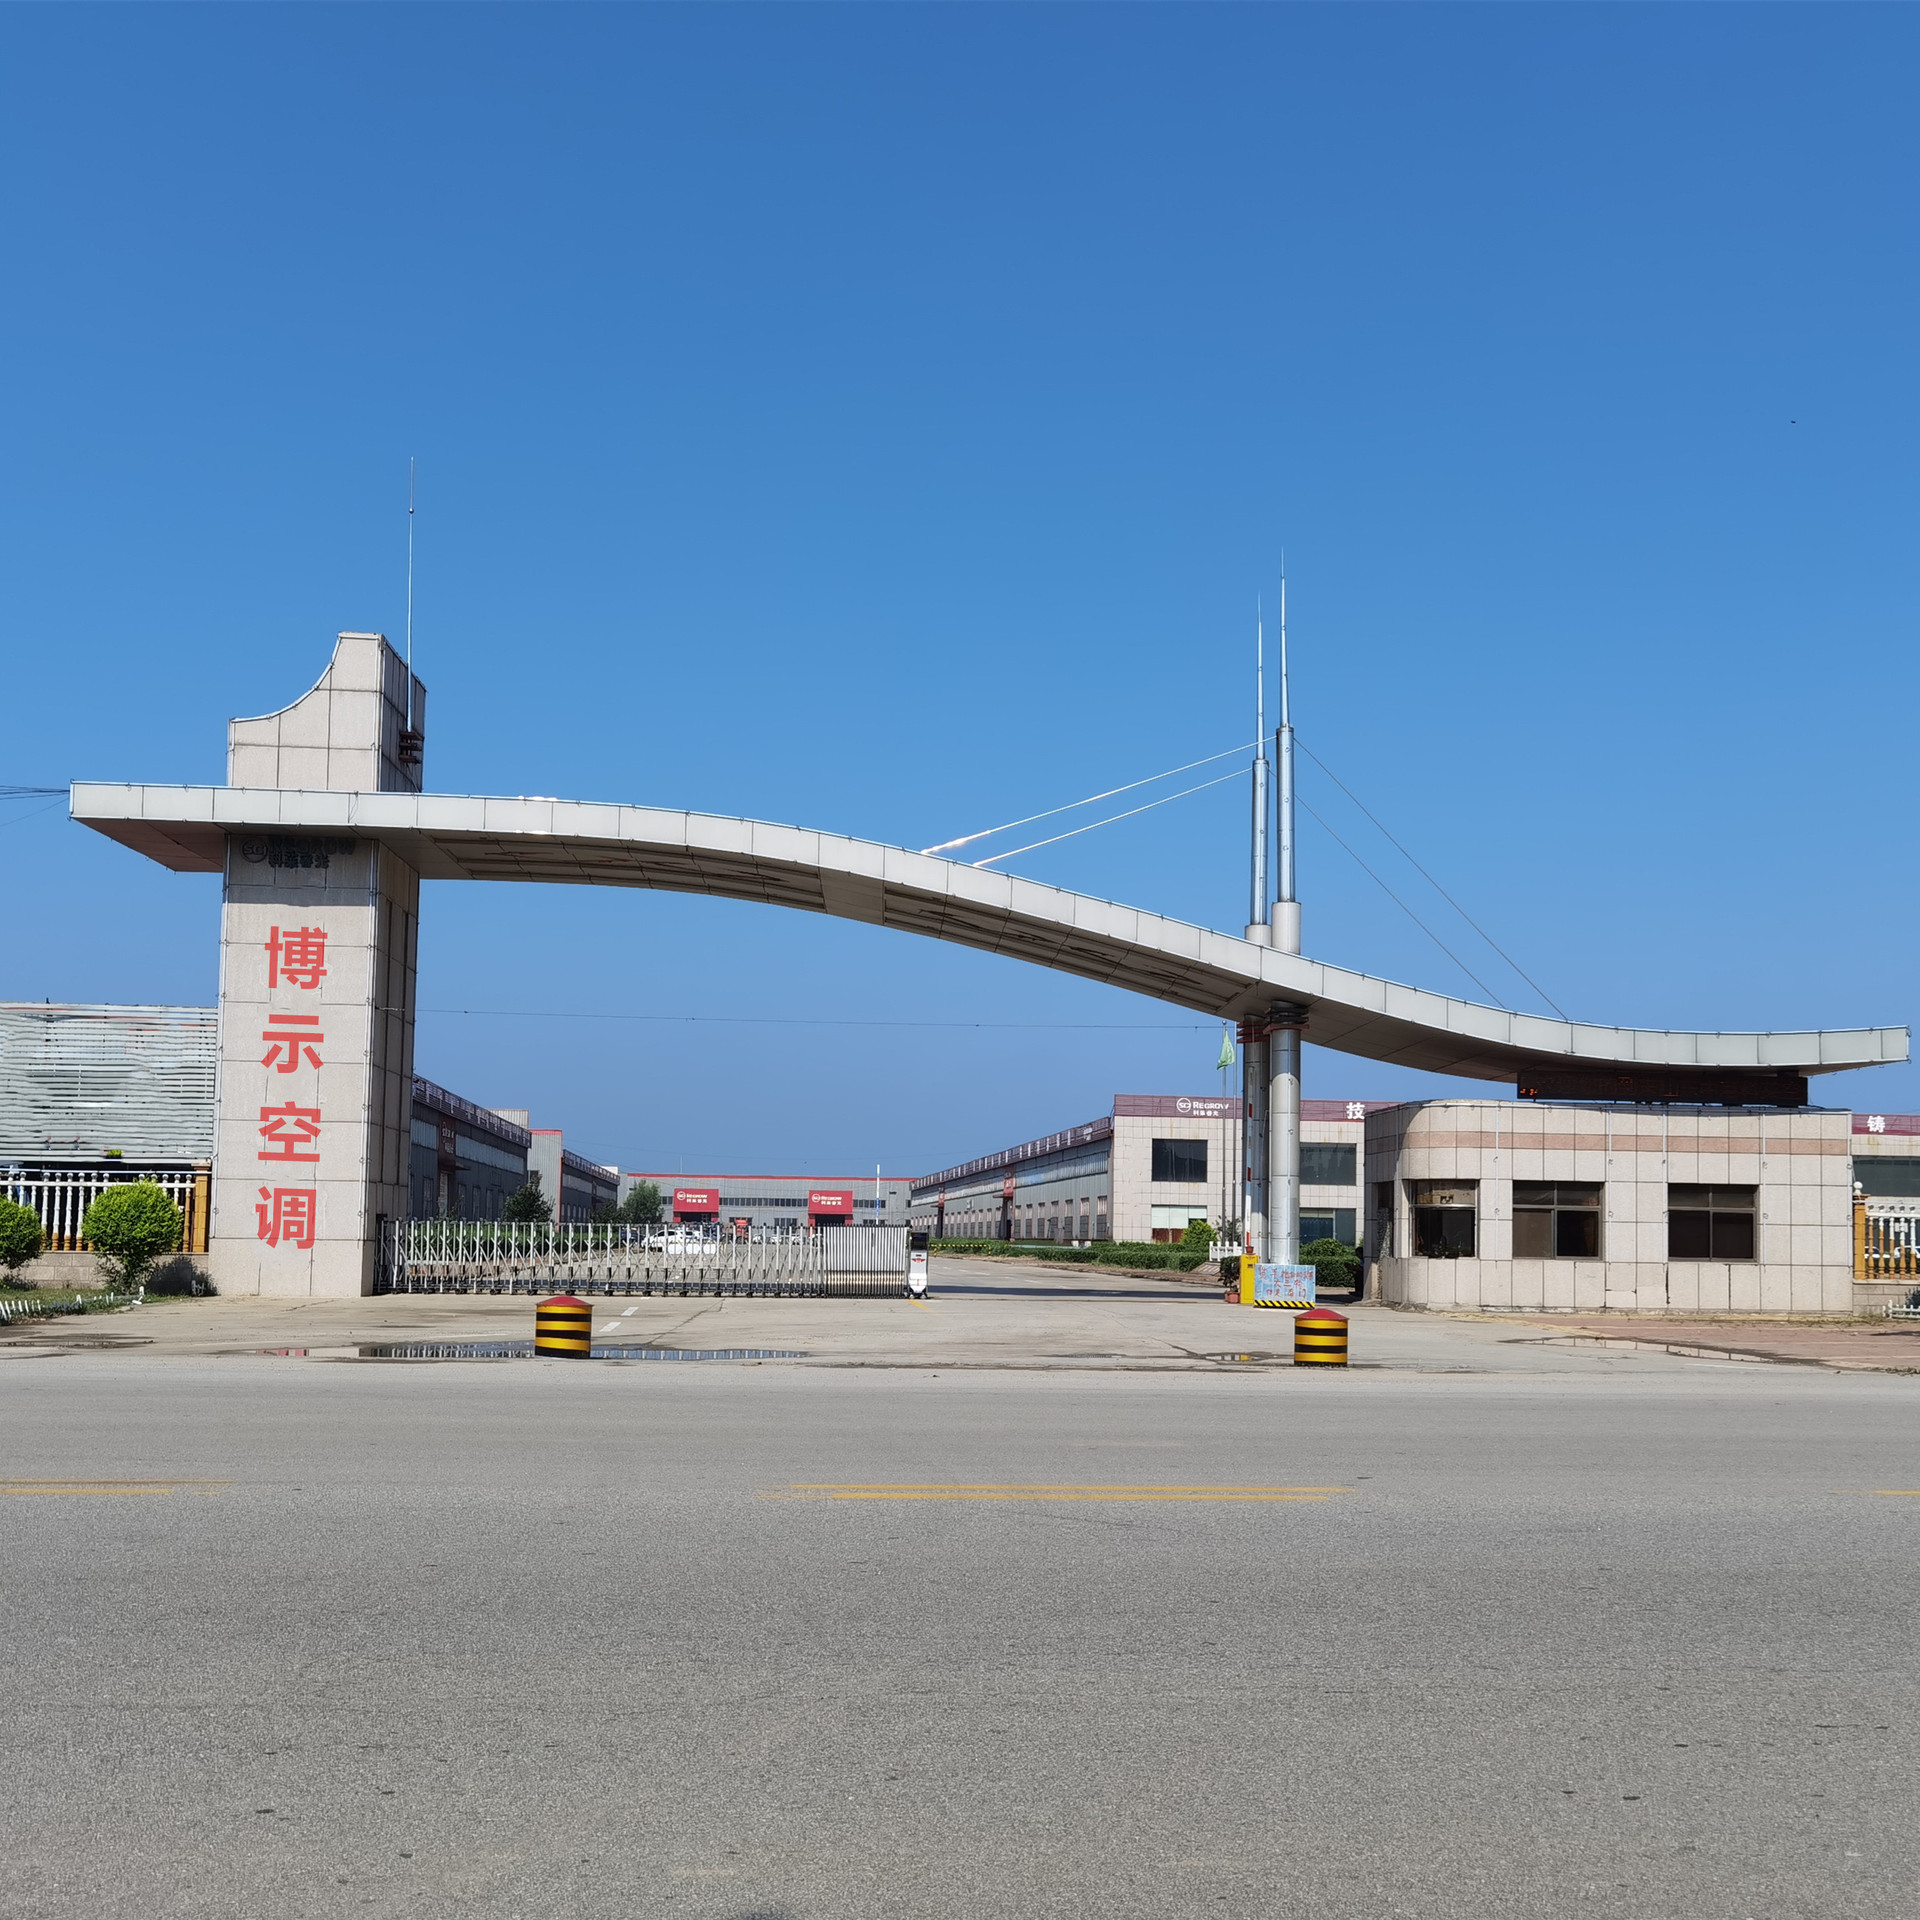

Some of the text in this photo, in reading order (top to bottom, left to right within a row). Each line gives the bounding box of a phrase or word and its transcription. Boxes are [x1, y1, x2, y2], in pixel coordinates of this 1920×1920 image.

[255, 926, 328, 1249] 博示空调
[1346, 1102, 1365, 1120] 技
[1867, 1115, 1886, 1133] 铸
